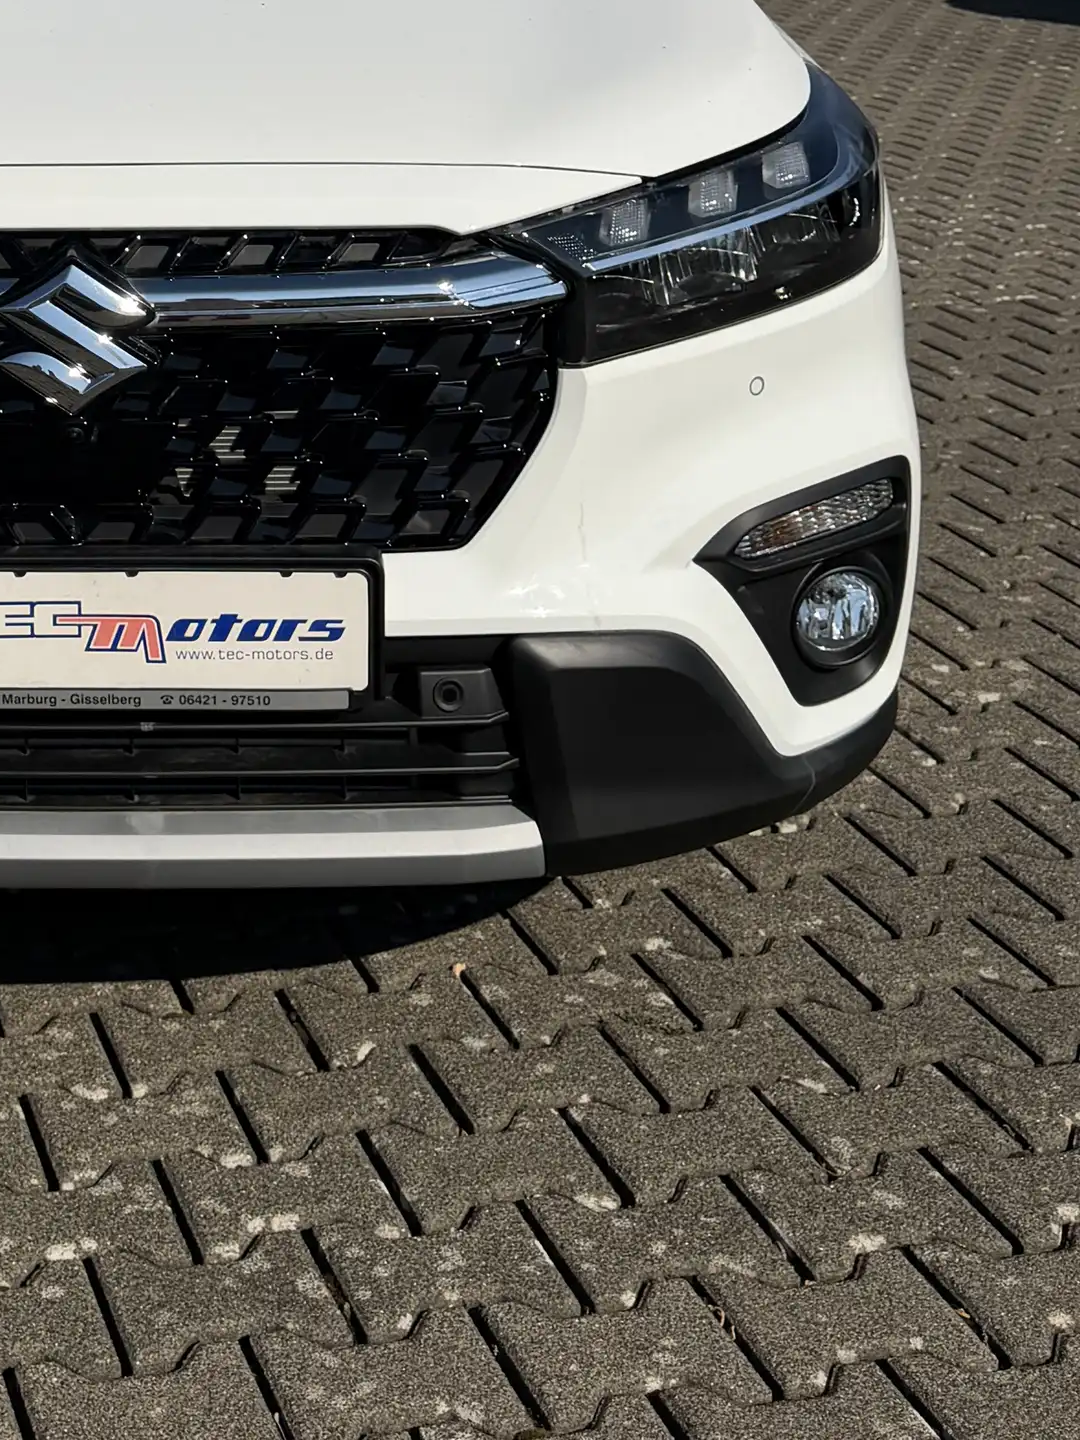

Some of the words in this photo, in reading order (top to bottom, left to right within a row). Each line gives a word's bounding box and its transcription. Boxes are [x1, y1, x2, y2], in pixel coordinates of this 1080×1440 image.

[175, 647, 334, 661] www.tec-motors.de
[2, 694, 57, 707] Marburg
[70, 693, 141, 707] Gisselberg
[179, 695, 217, 706] 06421
[231, 695, 271, 706] 97510
